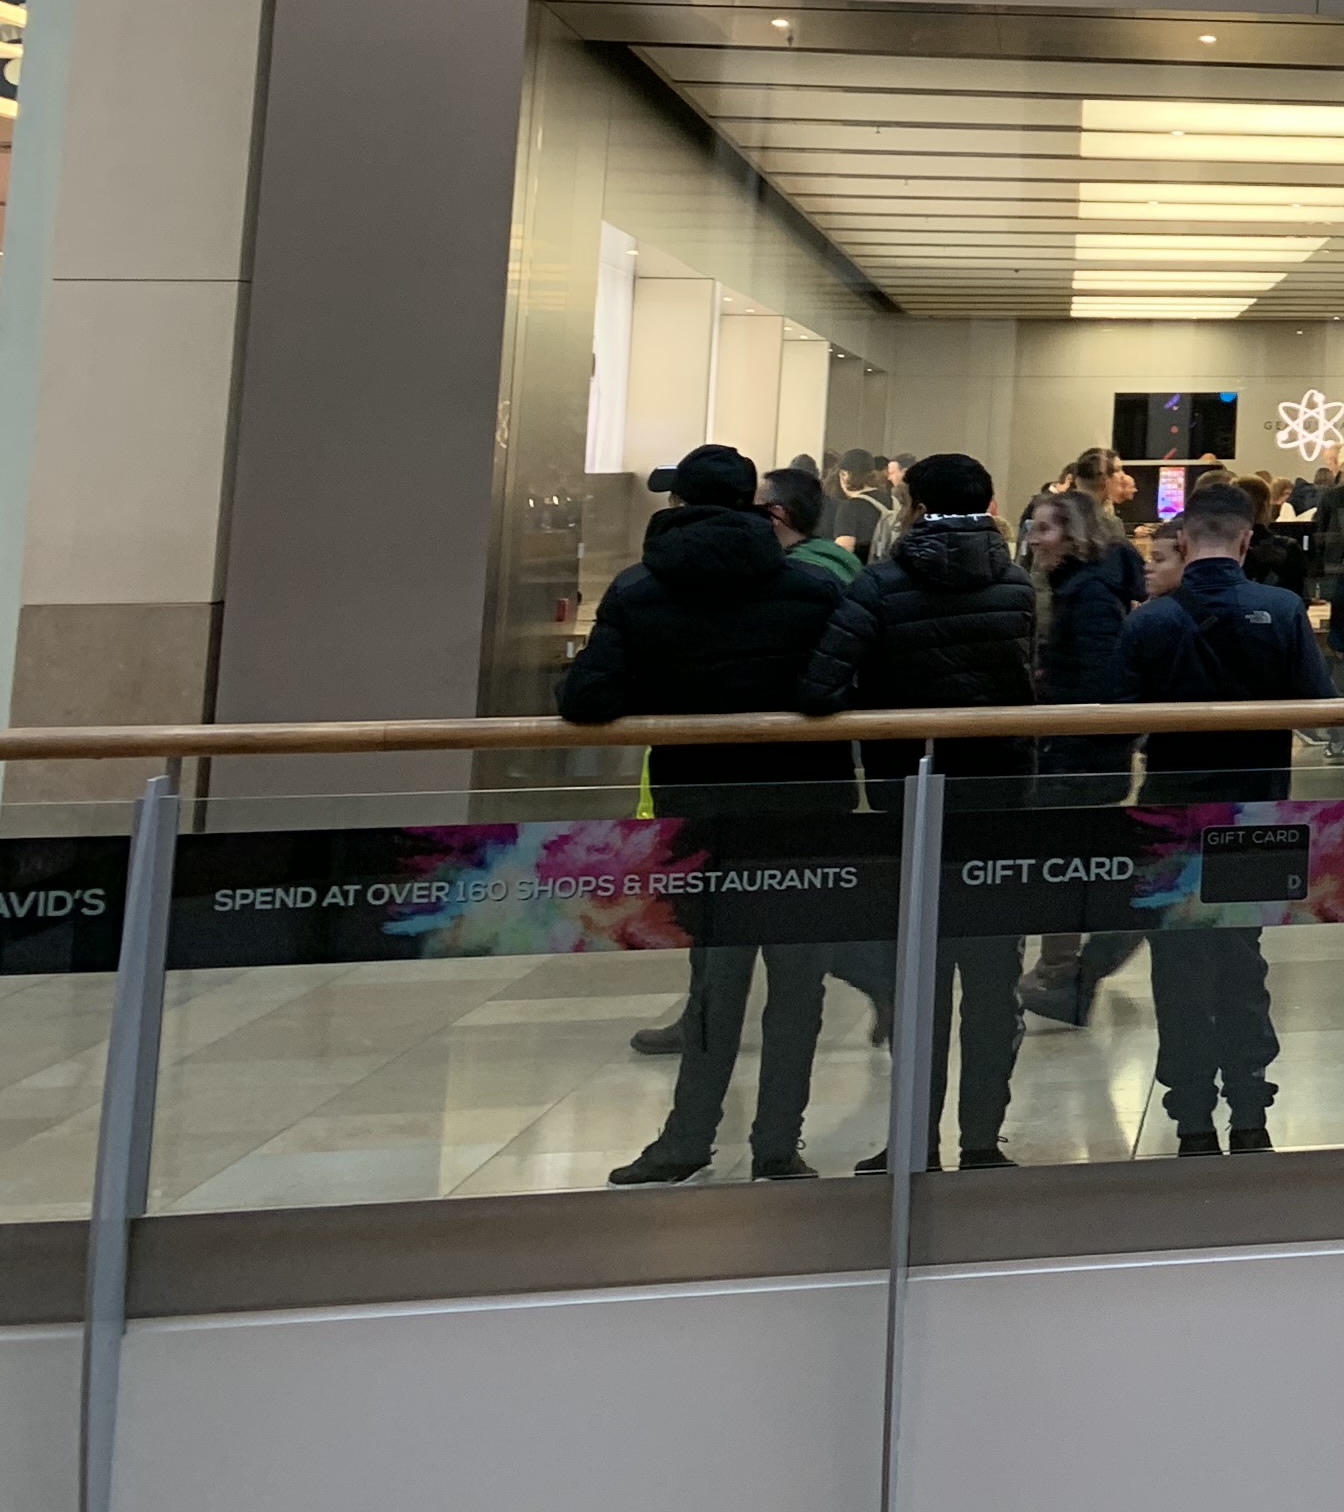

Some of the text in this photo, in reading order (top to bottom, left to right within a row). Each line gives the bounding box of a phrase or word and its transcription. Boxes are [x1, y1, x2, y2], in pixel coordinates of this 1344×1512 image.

[1207, 830, 1299, 845] GIFT CARD
[962, 859, 1036, 886] GIFT
[1042, 857, 1134, 882] CARD
[214, 867, 858, 911] SPEND AT OVER 160 SHOPS & RESTAURANTS
